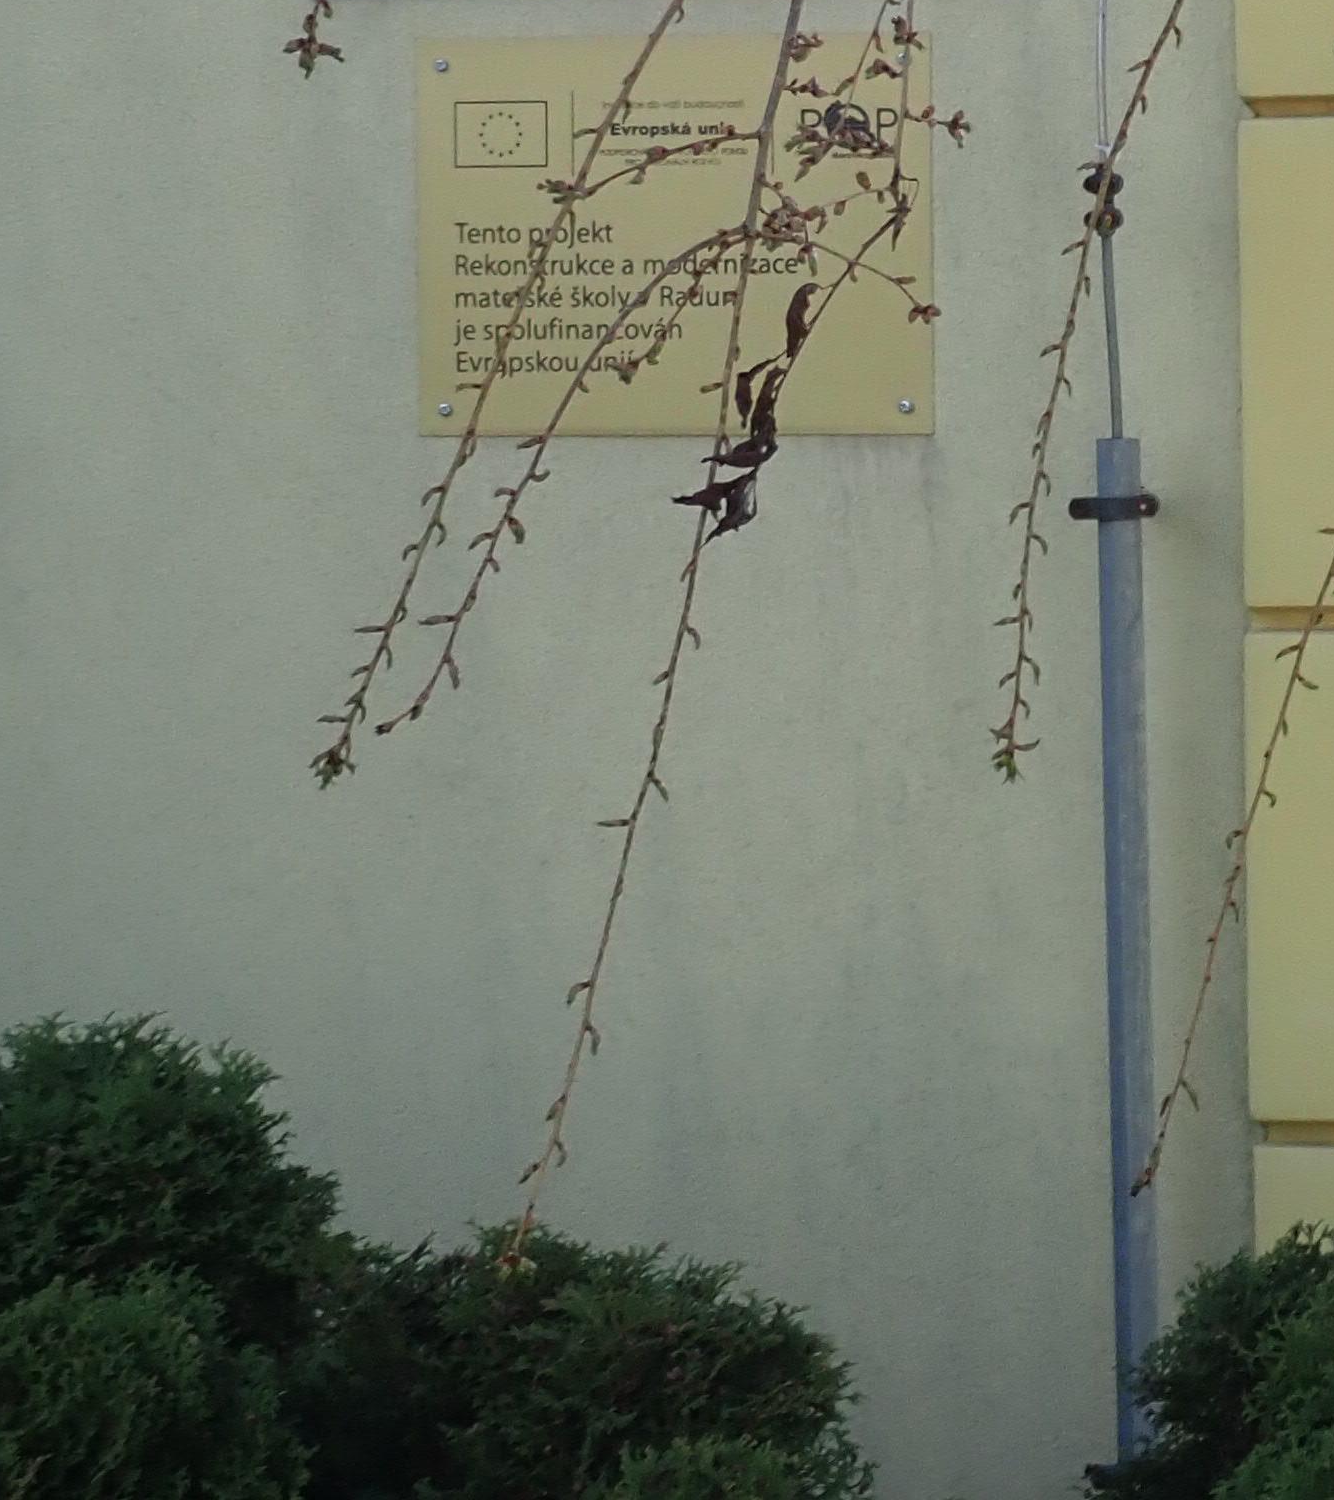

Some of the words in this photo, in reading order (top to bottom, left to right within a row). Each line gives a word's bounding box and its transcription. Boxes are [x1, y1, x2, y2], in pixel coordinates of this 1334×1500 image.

[609, 121, 692, 138] Evropská
[697, 121, 735, 136] uni
[454, 222, 522, 244] Tento
[620, 260, 634, 276] a
[454, 286, 564, 309] mateské
[570, 286, 632, 312] školy
[453, 319, 477, 346] je
[482, 318, 683, 347] spolufinanován
